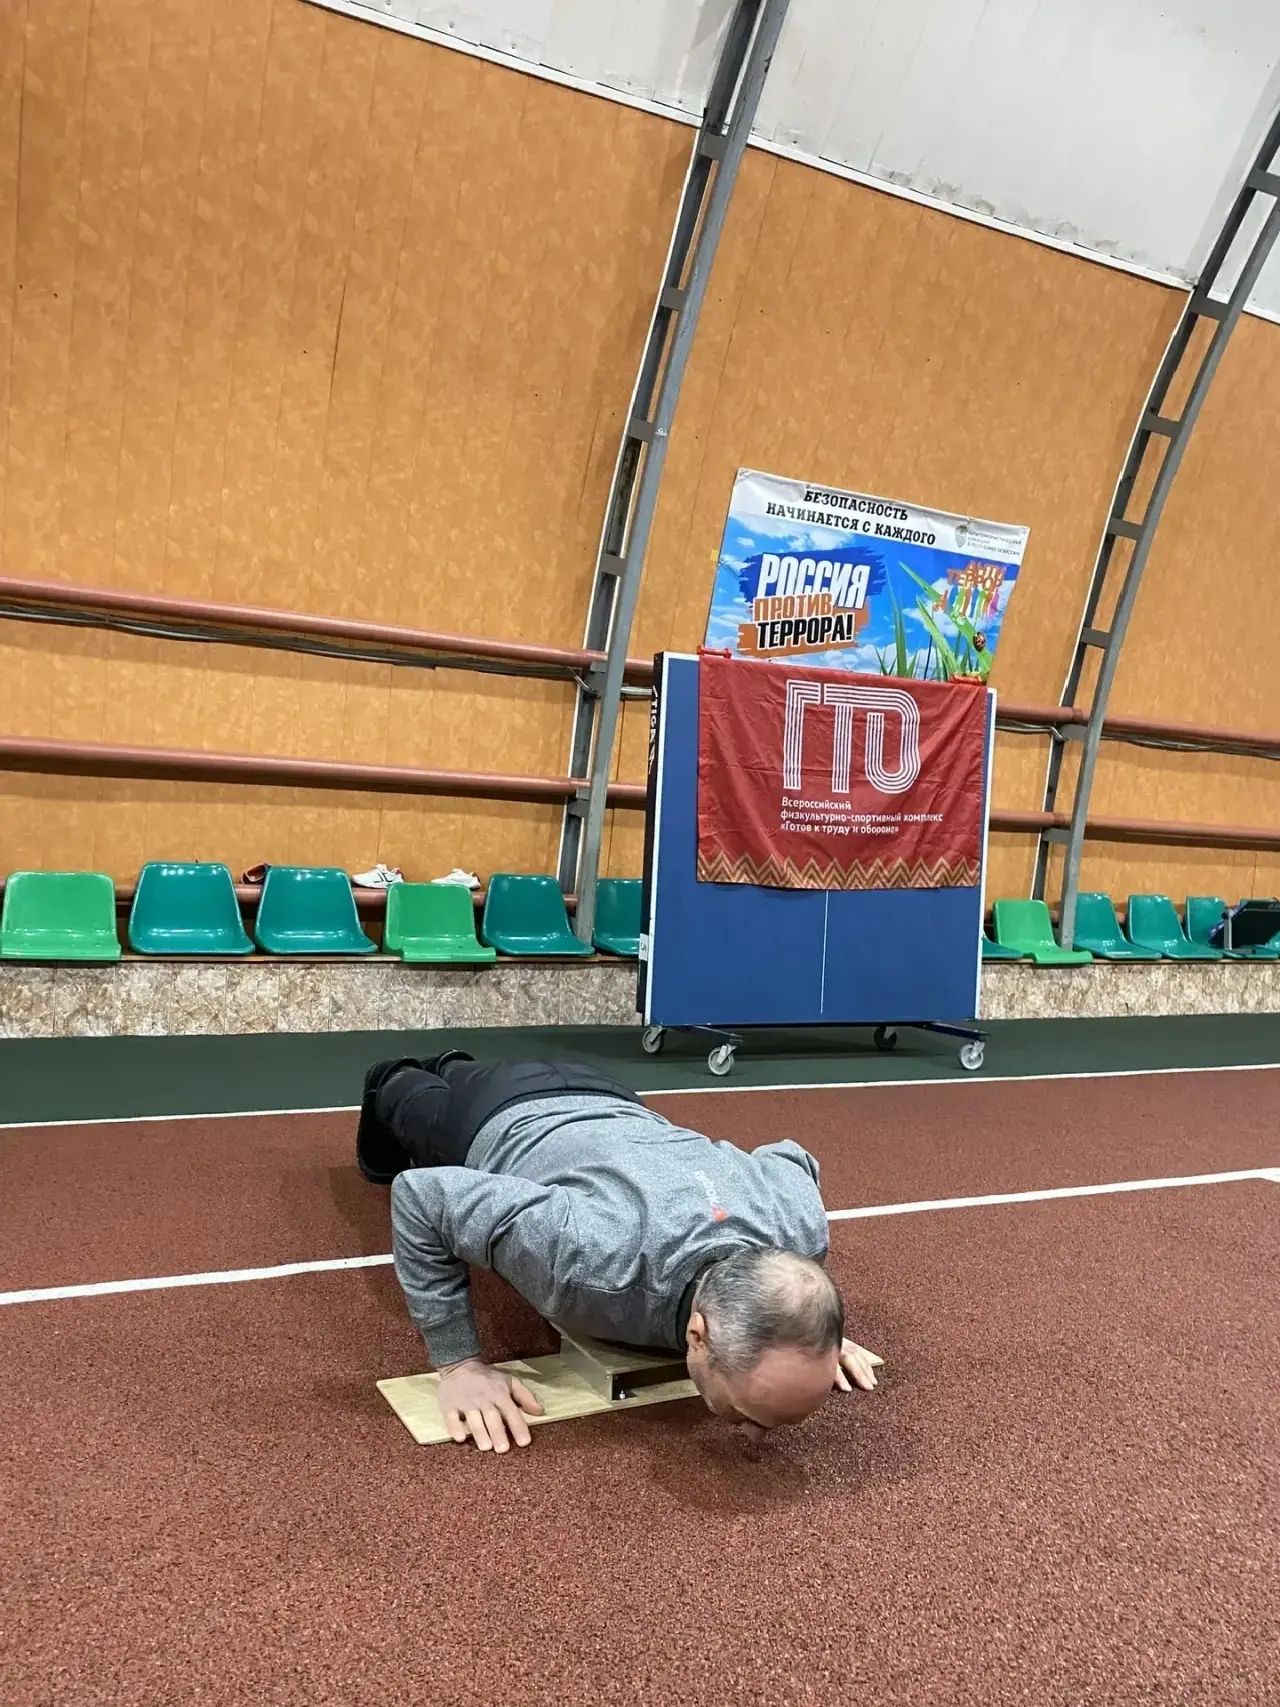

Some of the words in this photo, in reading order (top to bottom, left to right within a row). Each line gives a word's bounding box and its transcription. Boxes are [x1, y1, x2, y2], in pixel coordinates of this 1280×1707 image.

[803, 490, 909, 521] БЕЗОПАСНОСТЬ
[765, 502, 859, 531] НАЧИНАЕТСЯ
[862, 521, 871, 533] С
[874, 523, 936, 545] КАЖДОГО
[757, 553, 871, 609] РОССИЯ
[754, 593, 832, 621] ПРОТИВ
[757, 614, 854, 649] ТЕРРОРА!
[783, 680, 921, 794] ГТО
[780, 809, 901, 824] физкультурно-спортивный
[903, 813, 943, 822] комплекс
[781, 797, 851, 810] Всероссийский
[780, 820, 812, 832] «Готов
[814, 824, 820, 833] к
[822, 824, 850, 836] труду
[852, 826, 858, 834] и
[860, 824, 899, 835] обороне»
